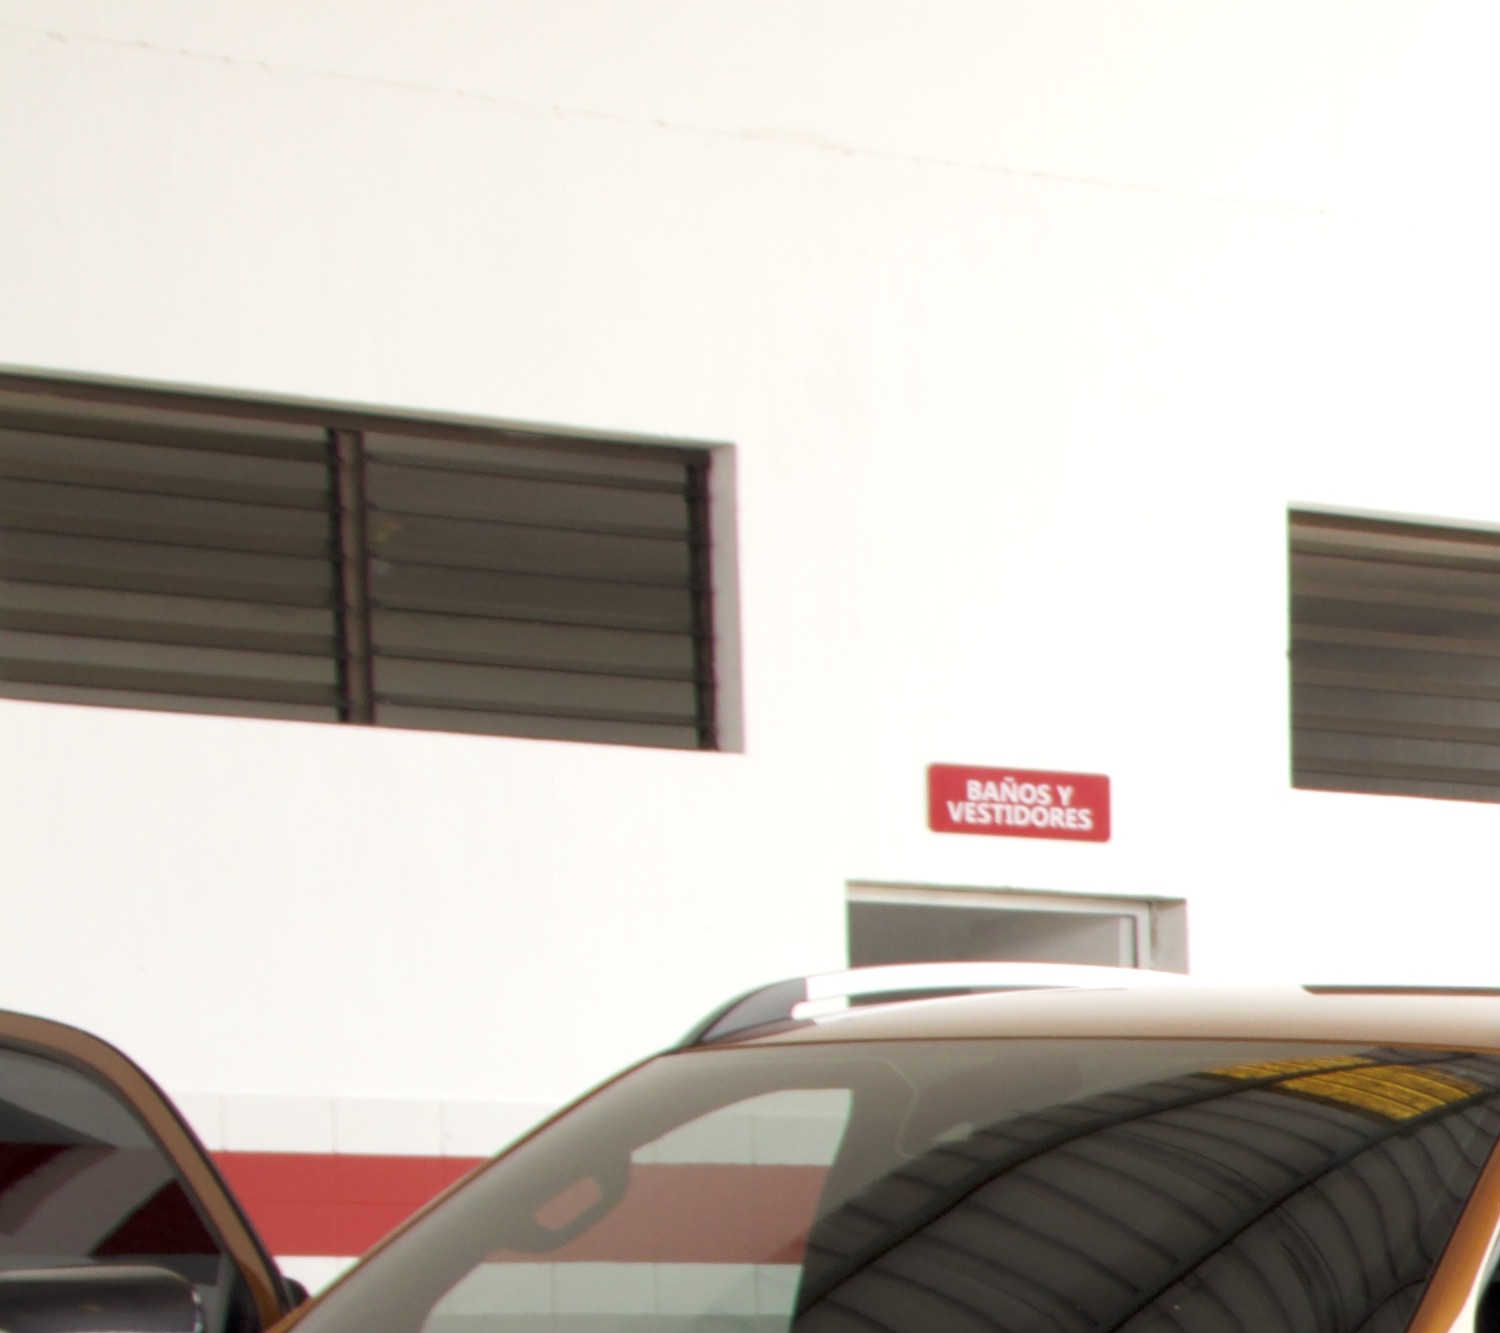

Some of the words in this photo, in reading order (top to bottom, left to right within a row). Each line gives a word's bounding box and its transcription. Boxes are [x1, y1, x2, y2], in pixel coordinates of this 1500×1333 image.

[966, 776, 1052, 805] BAÑOS
[1056, 785, 1074, 806] Y
[946, 801, 1094, 831] VESTIDORES
